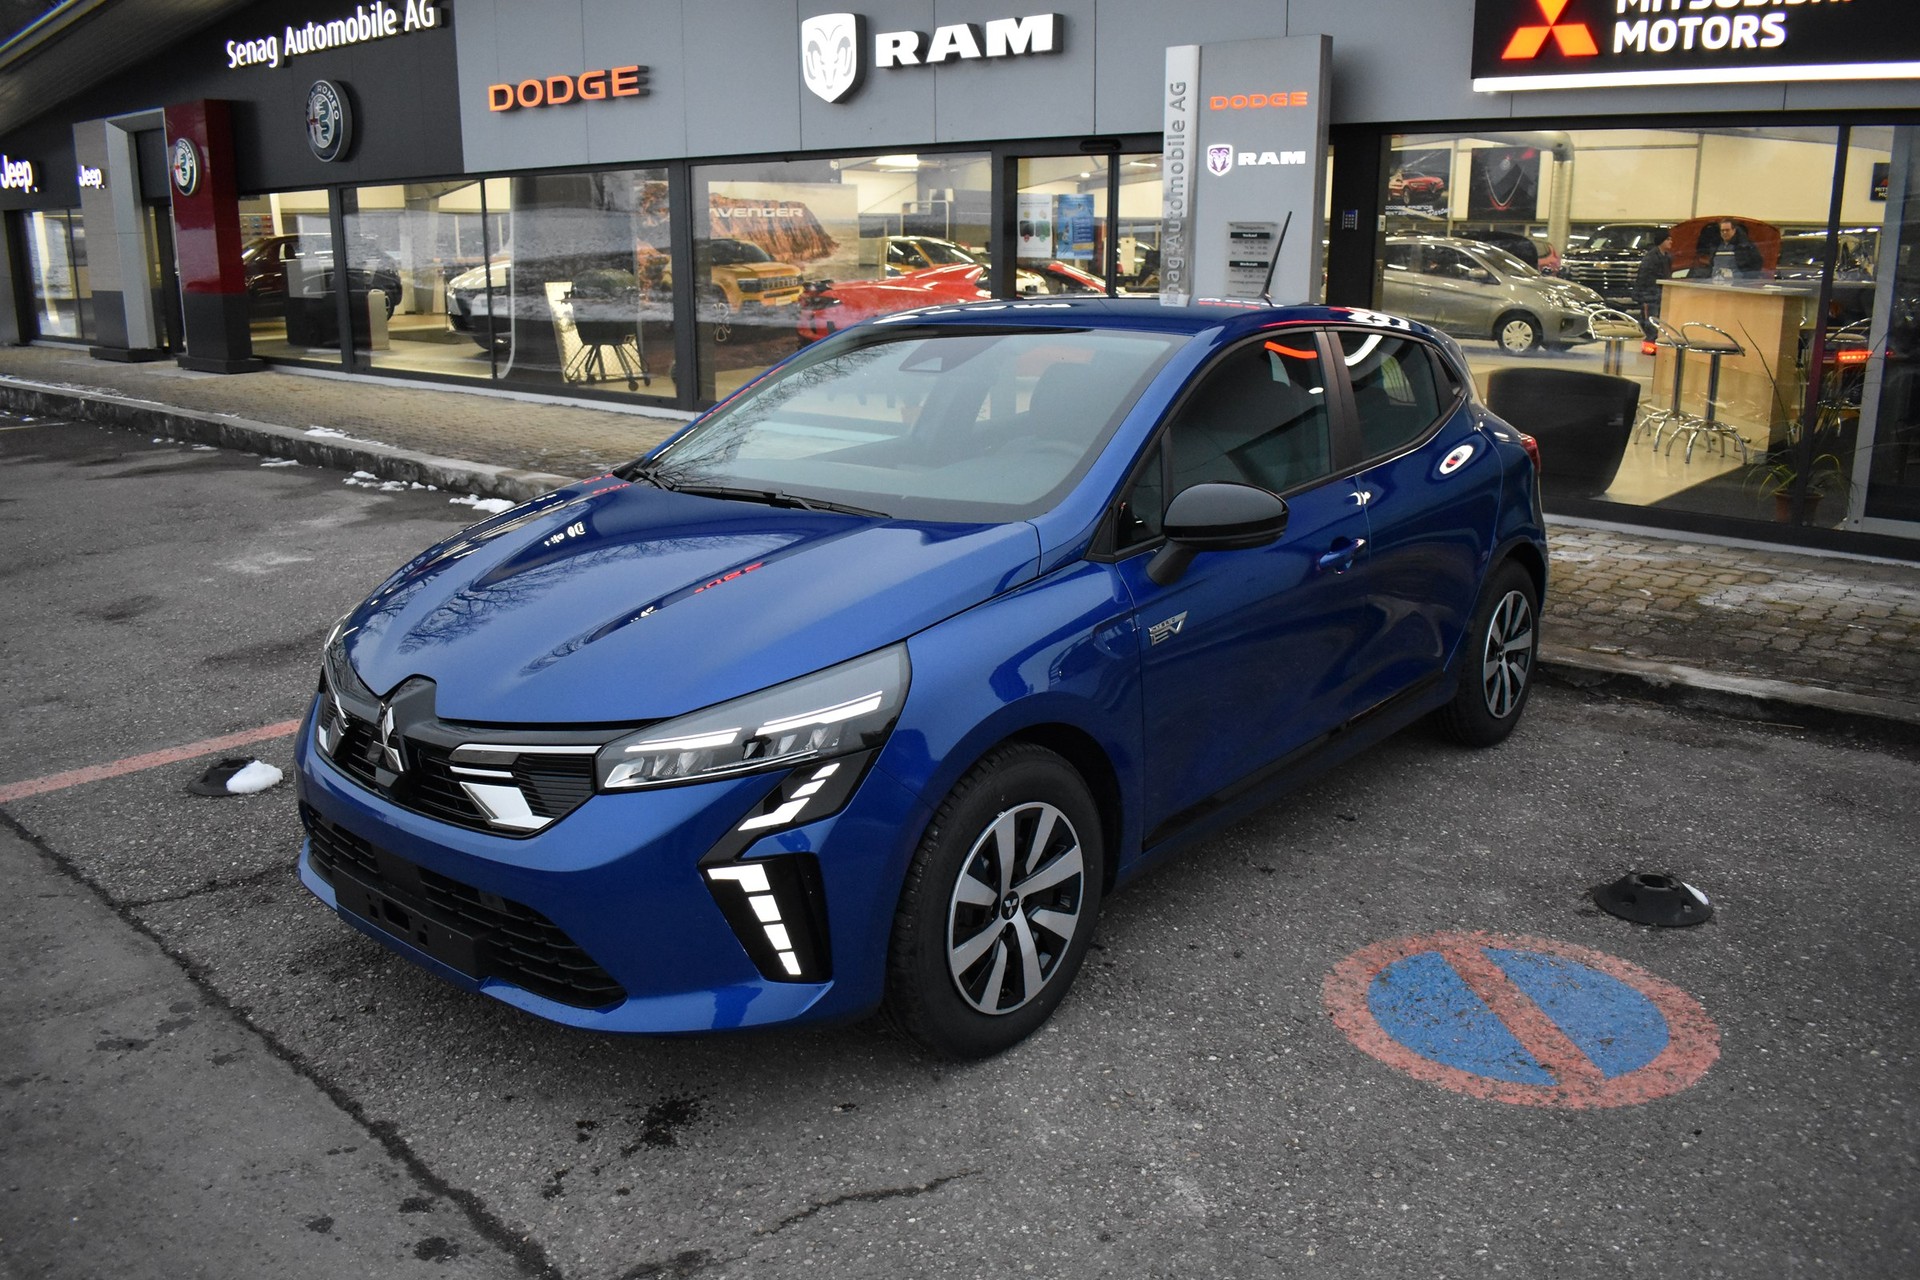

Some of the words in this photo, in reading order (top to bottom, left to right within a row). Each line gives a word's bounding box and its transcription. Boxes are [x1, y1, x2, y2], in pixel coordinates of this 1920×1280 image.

[226, 39, 278, 69] Senag
[284, 1, 398, 56] Automobile
[403, 0, 435, 32] AG
[876, 14, 1055, 68] RAM
[1613, 12, 1787, 53] MOTORS
[316, 84, 341, 120] ROMEO
[488, 65, 641, 112] DODGE
[1169, 80, 1187, 112] AG
[1209, 91, 1308, 111] DODGE
[0, 154, 34, 194] Jeep
[79, 165, 102, 189] Jeep
[1238, 151, 1306, 166] RAM
[1165, 119, 1186, 247] Automobile
